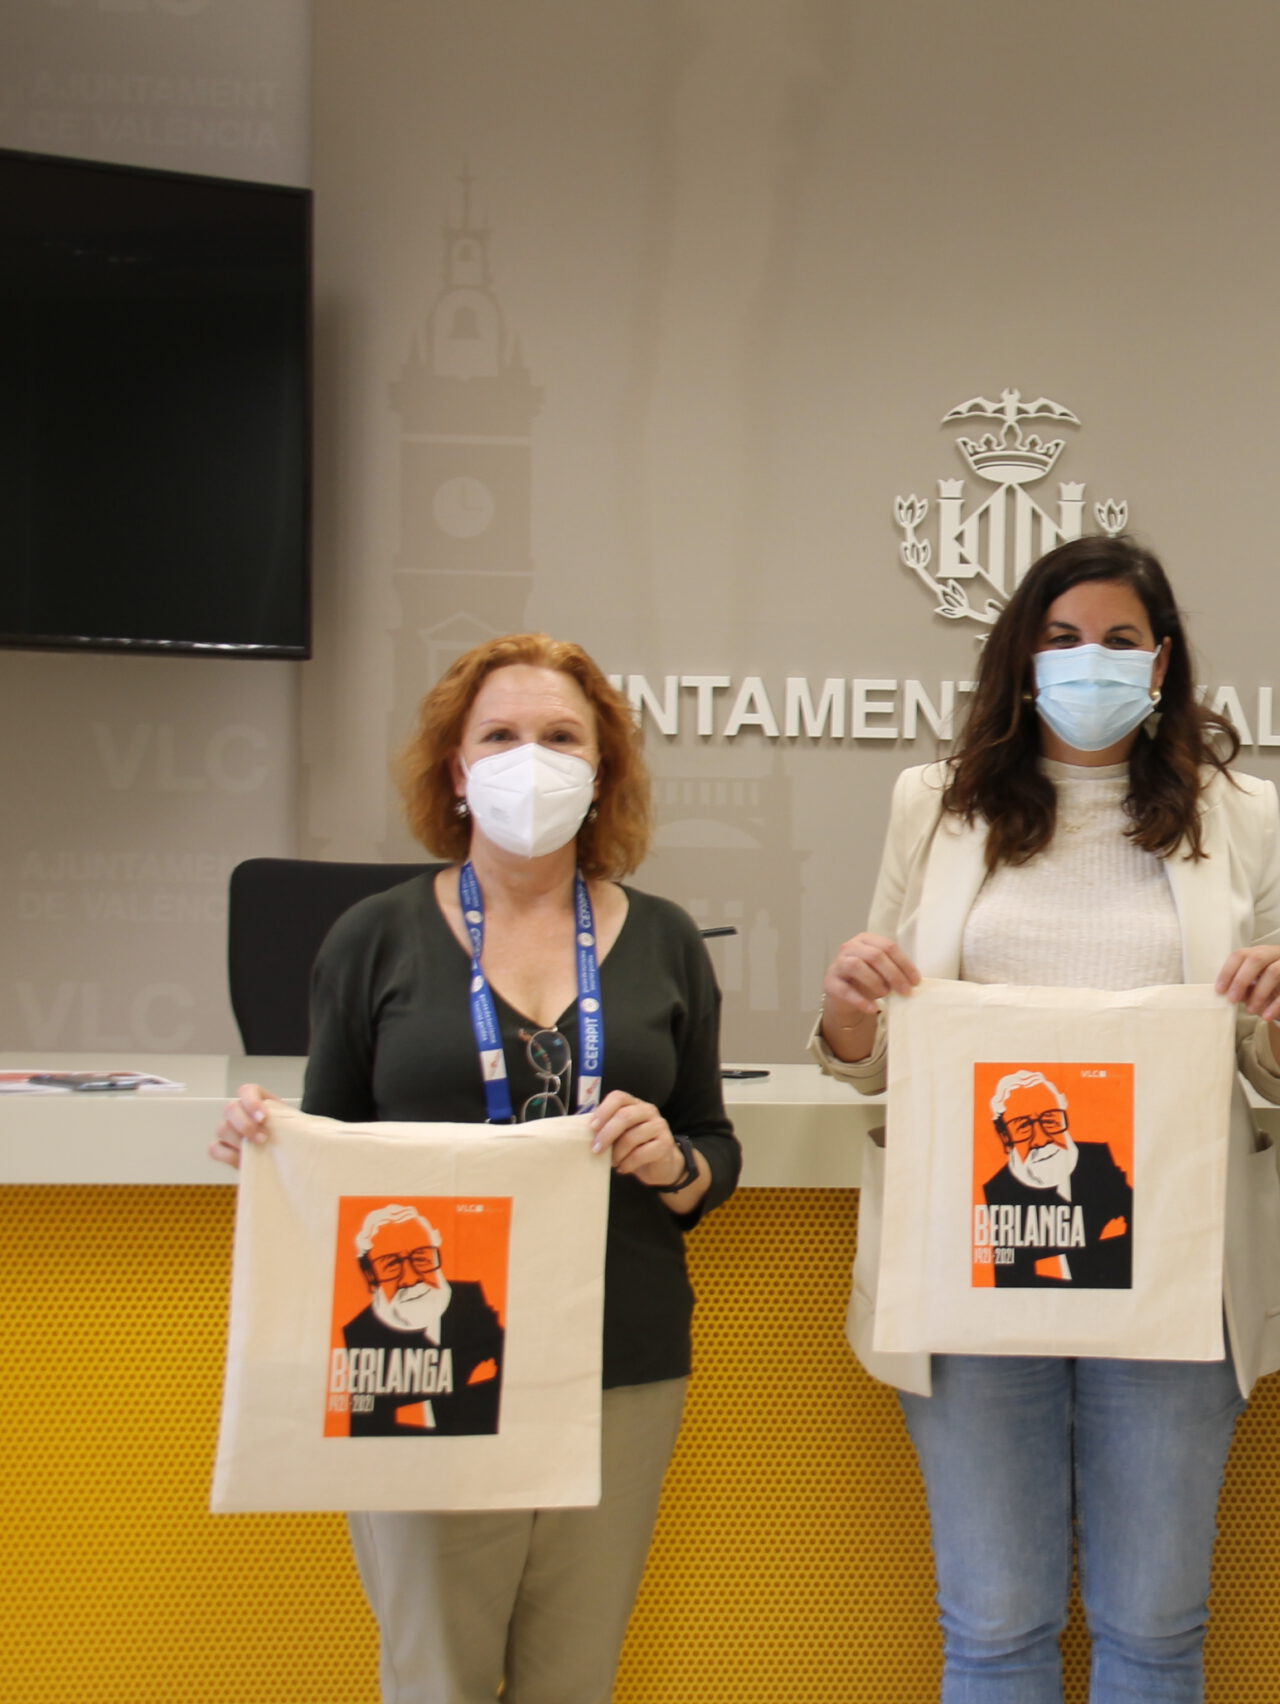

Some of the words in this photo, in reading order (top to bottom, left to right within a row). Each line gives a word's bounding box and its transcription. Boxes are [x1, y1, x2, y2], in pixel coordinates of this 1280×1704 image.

[608, 674, 980, 740] NTAMEN
[93, 722, 272, 795] VLC
[12, 980, 198, 1052] VLC
[975, 1204, 1086, 1247] BERLANGA
[330, 1347, 454, 1393] BERLANGA
